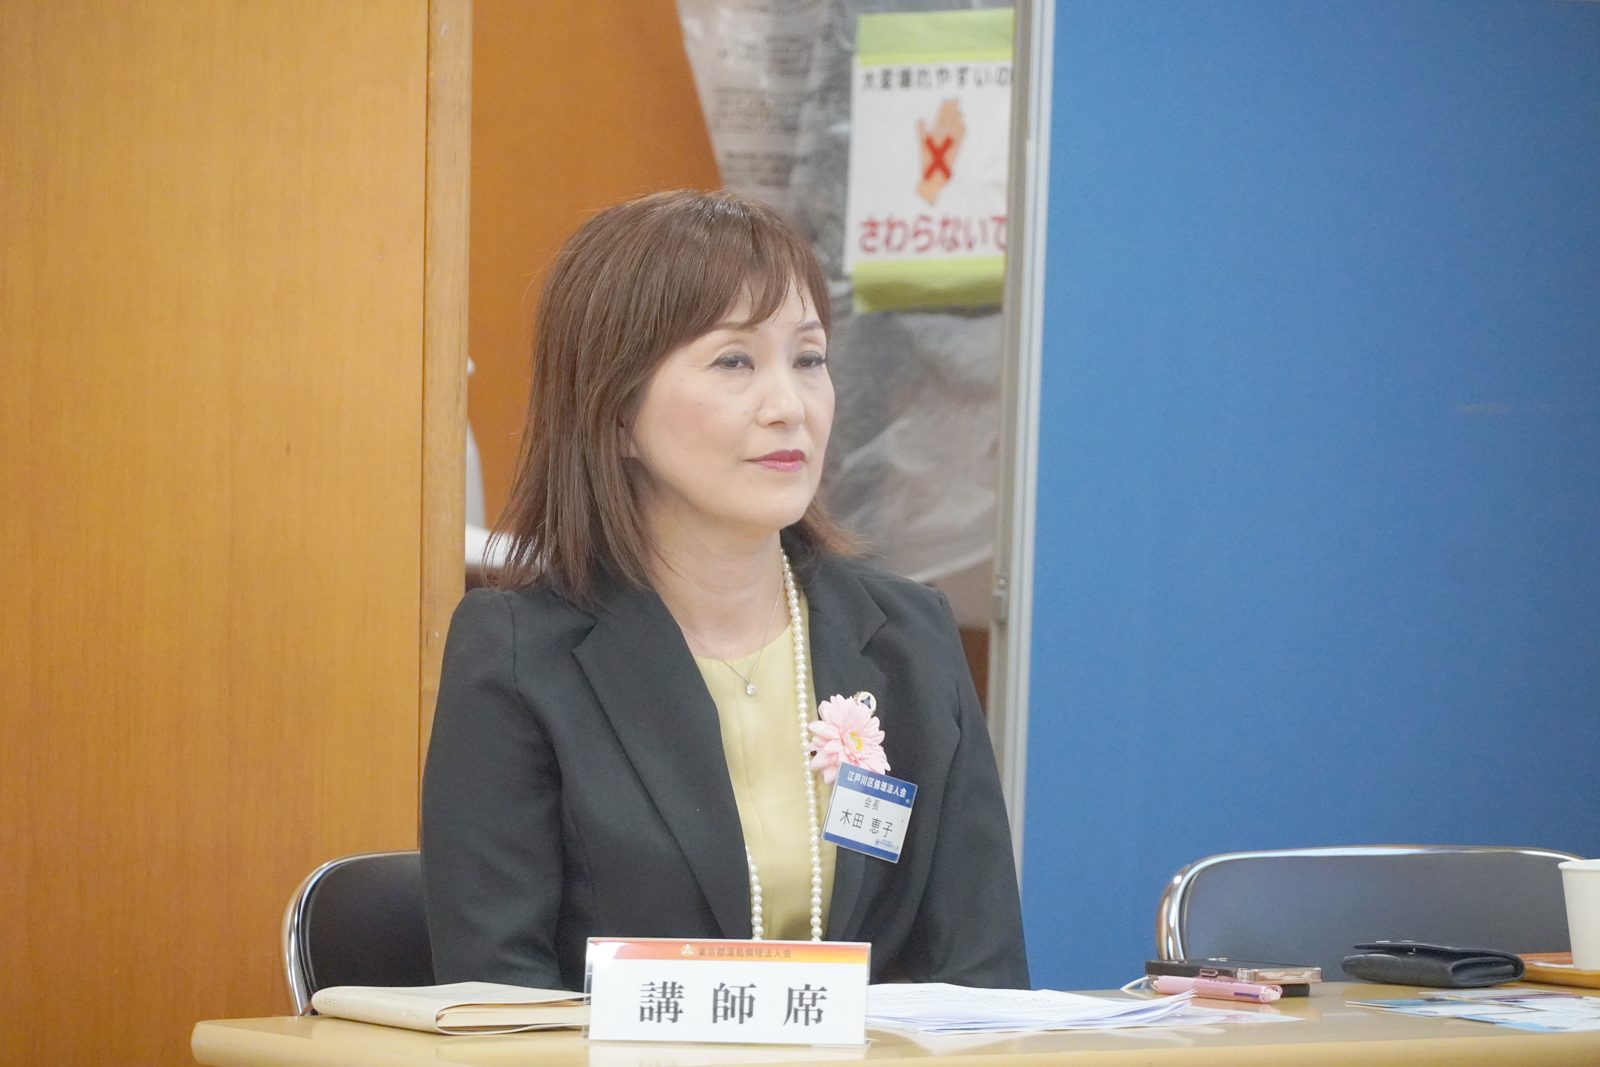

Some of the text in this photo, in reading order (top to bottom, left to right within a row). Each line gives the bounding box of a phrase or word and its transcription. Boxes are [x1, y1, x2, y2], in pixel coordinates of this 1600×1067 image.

[864, 797, 880, 811] 会長
[840, 808, 893, 838] 木田 恵子
[639, 981, 828, 1026] 講師席
